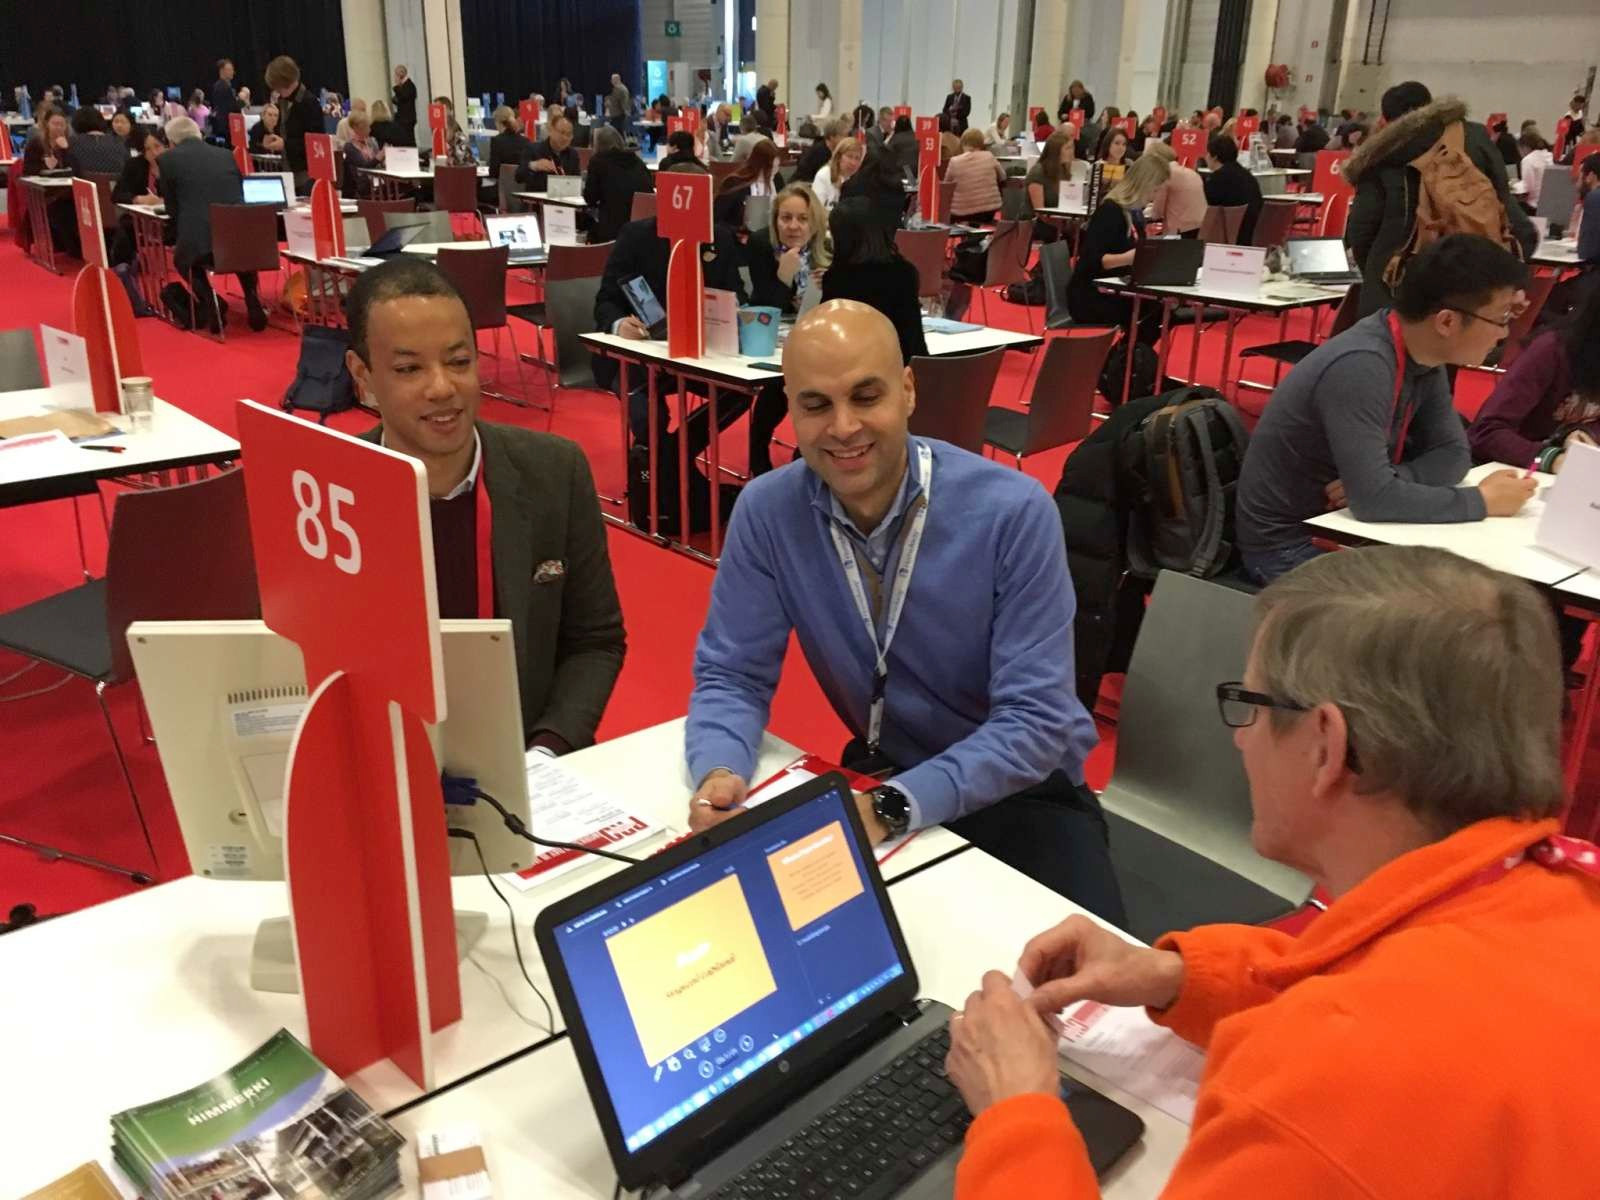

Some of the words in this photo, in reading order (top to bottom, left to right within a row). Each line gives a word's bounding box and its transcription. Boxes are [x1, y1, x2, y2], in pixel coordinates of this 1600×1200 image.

[1181, 133, 1197, 145] 52
[672, 185, 694, 210] 67
[292, 469, 361, 575] 85
[187, 1077, 272, 1126] HIMMERKI
